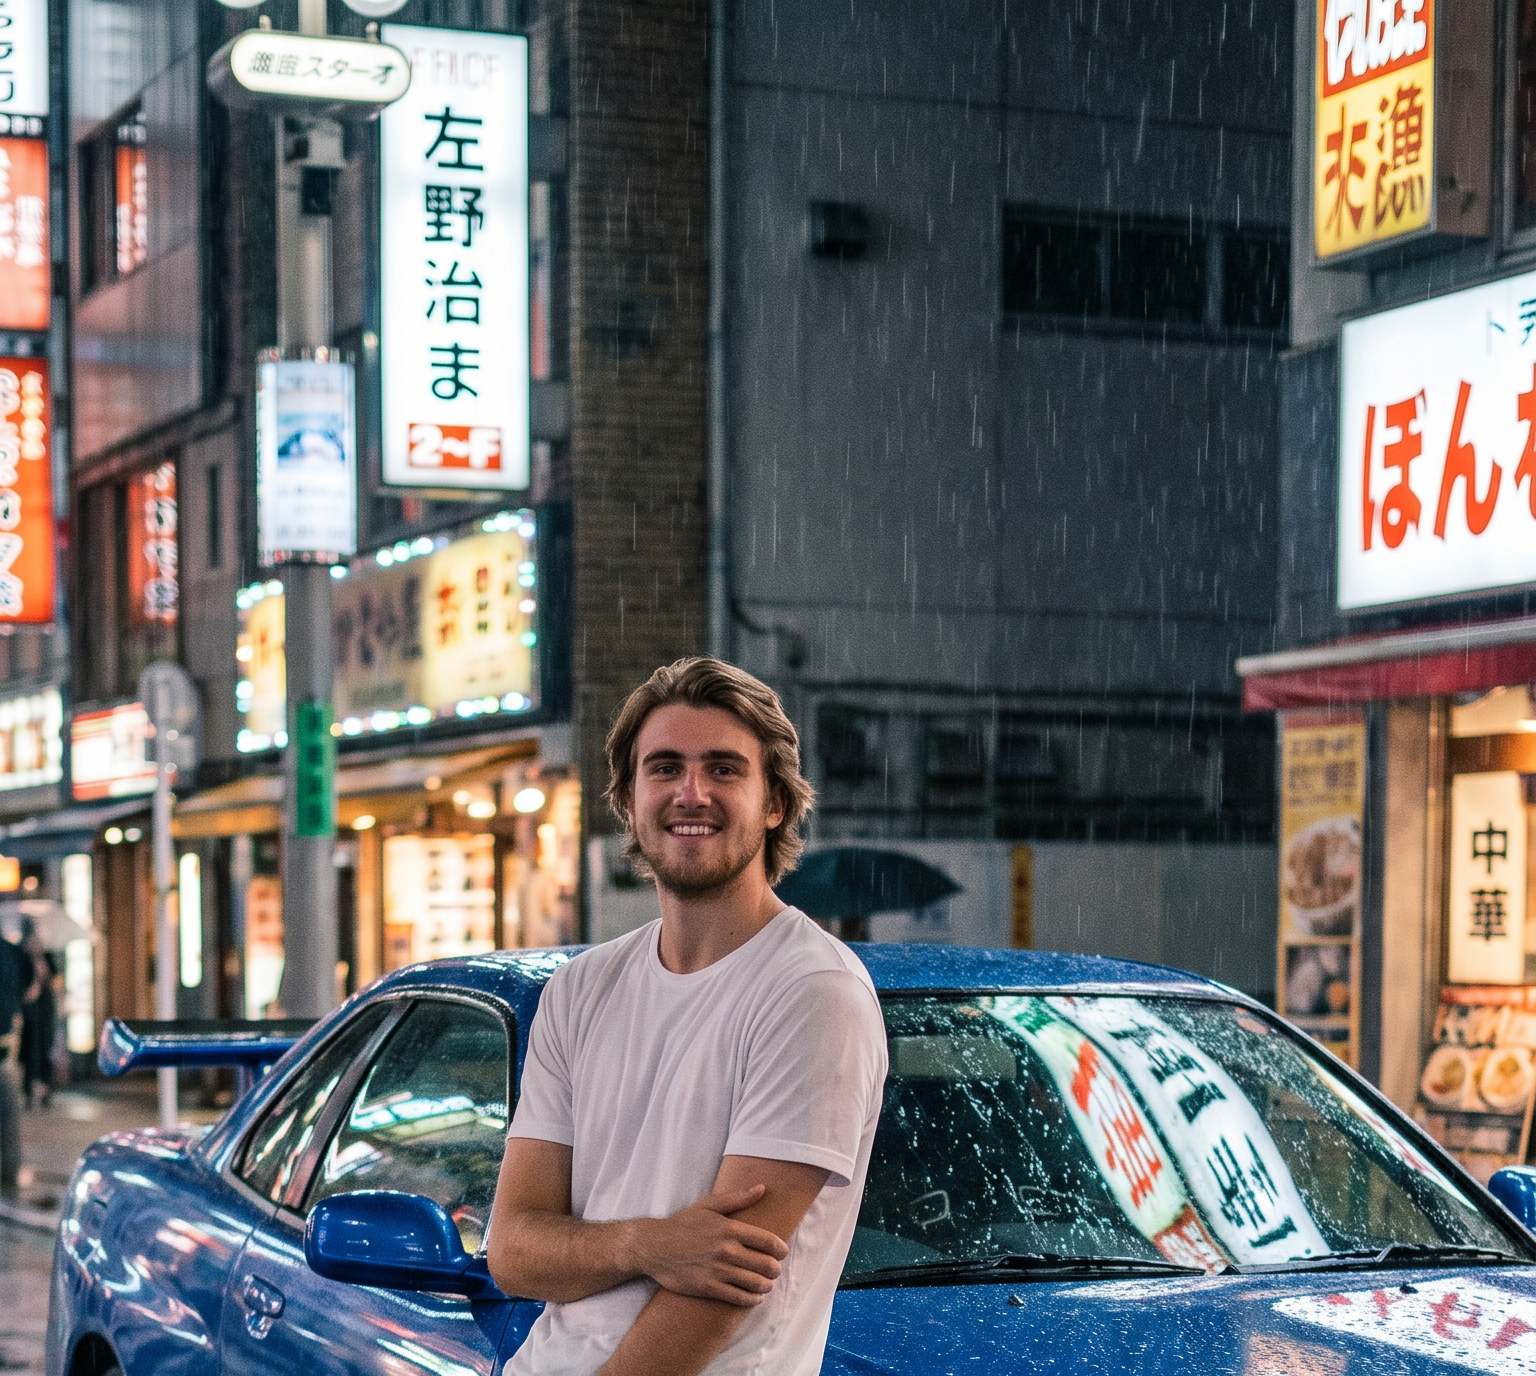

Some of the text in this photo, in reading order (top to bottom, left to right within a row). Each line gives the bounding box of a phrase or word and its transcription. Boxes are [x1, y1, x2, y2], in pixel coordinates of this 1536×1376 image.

[424, 106, 484, 400] 左野治ま
[1470, 821, 1508, 941] 中華
